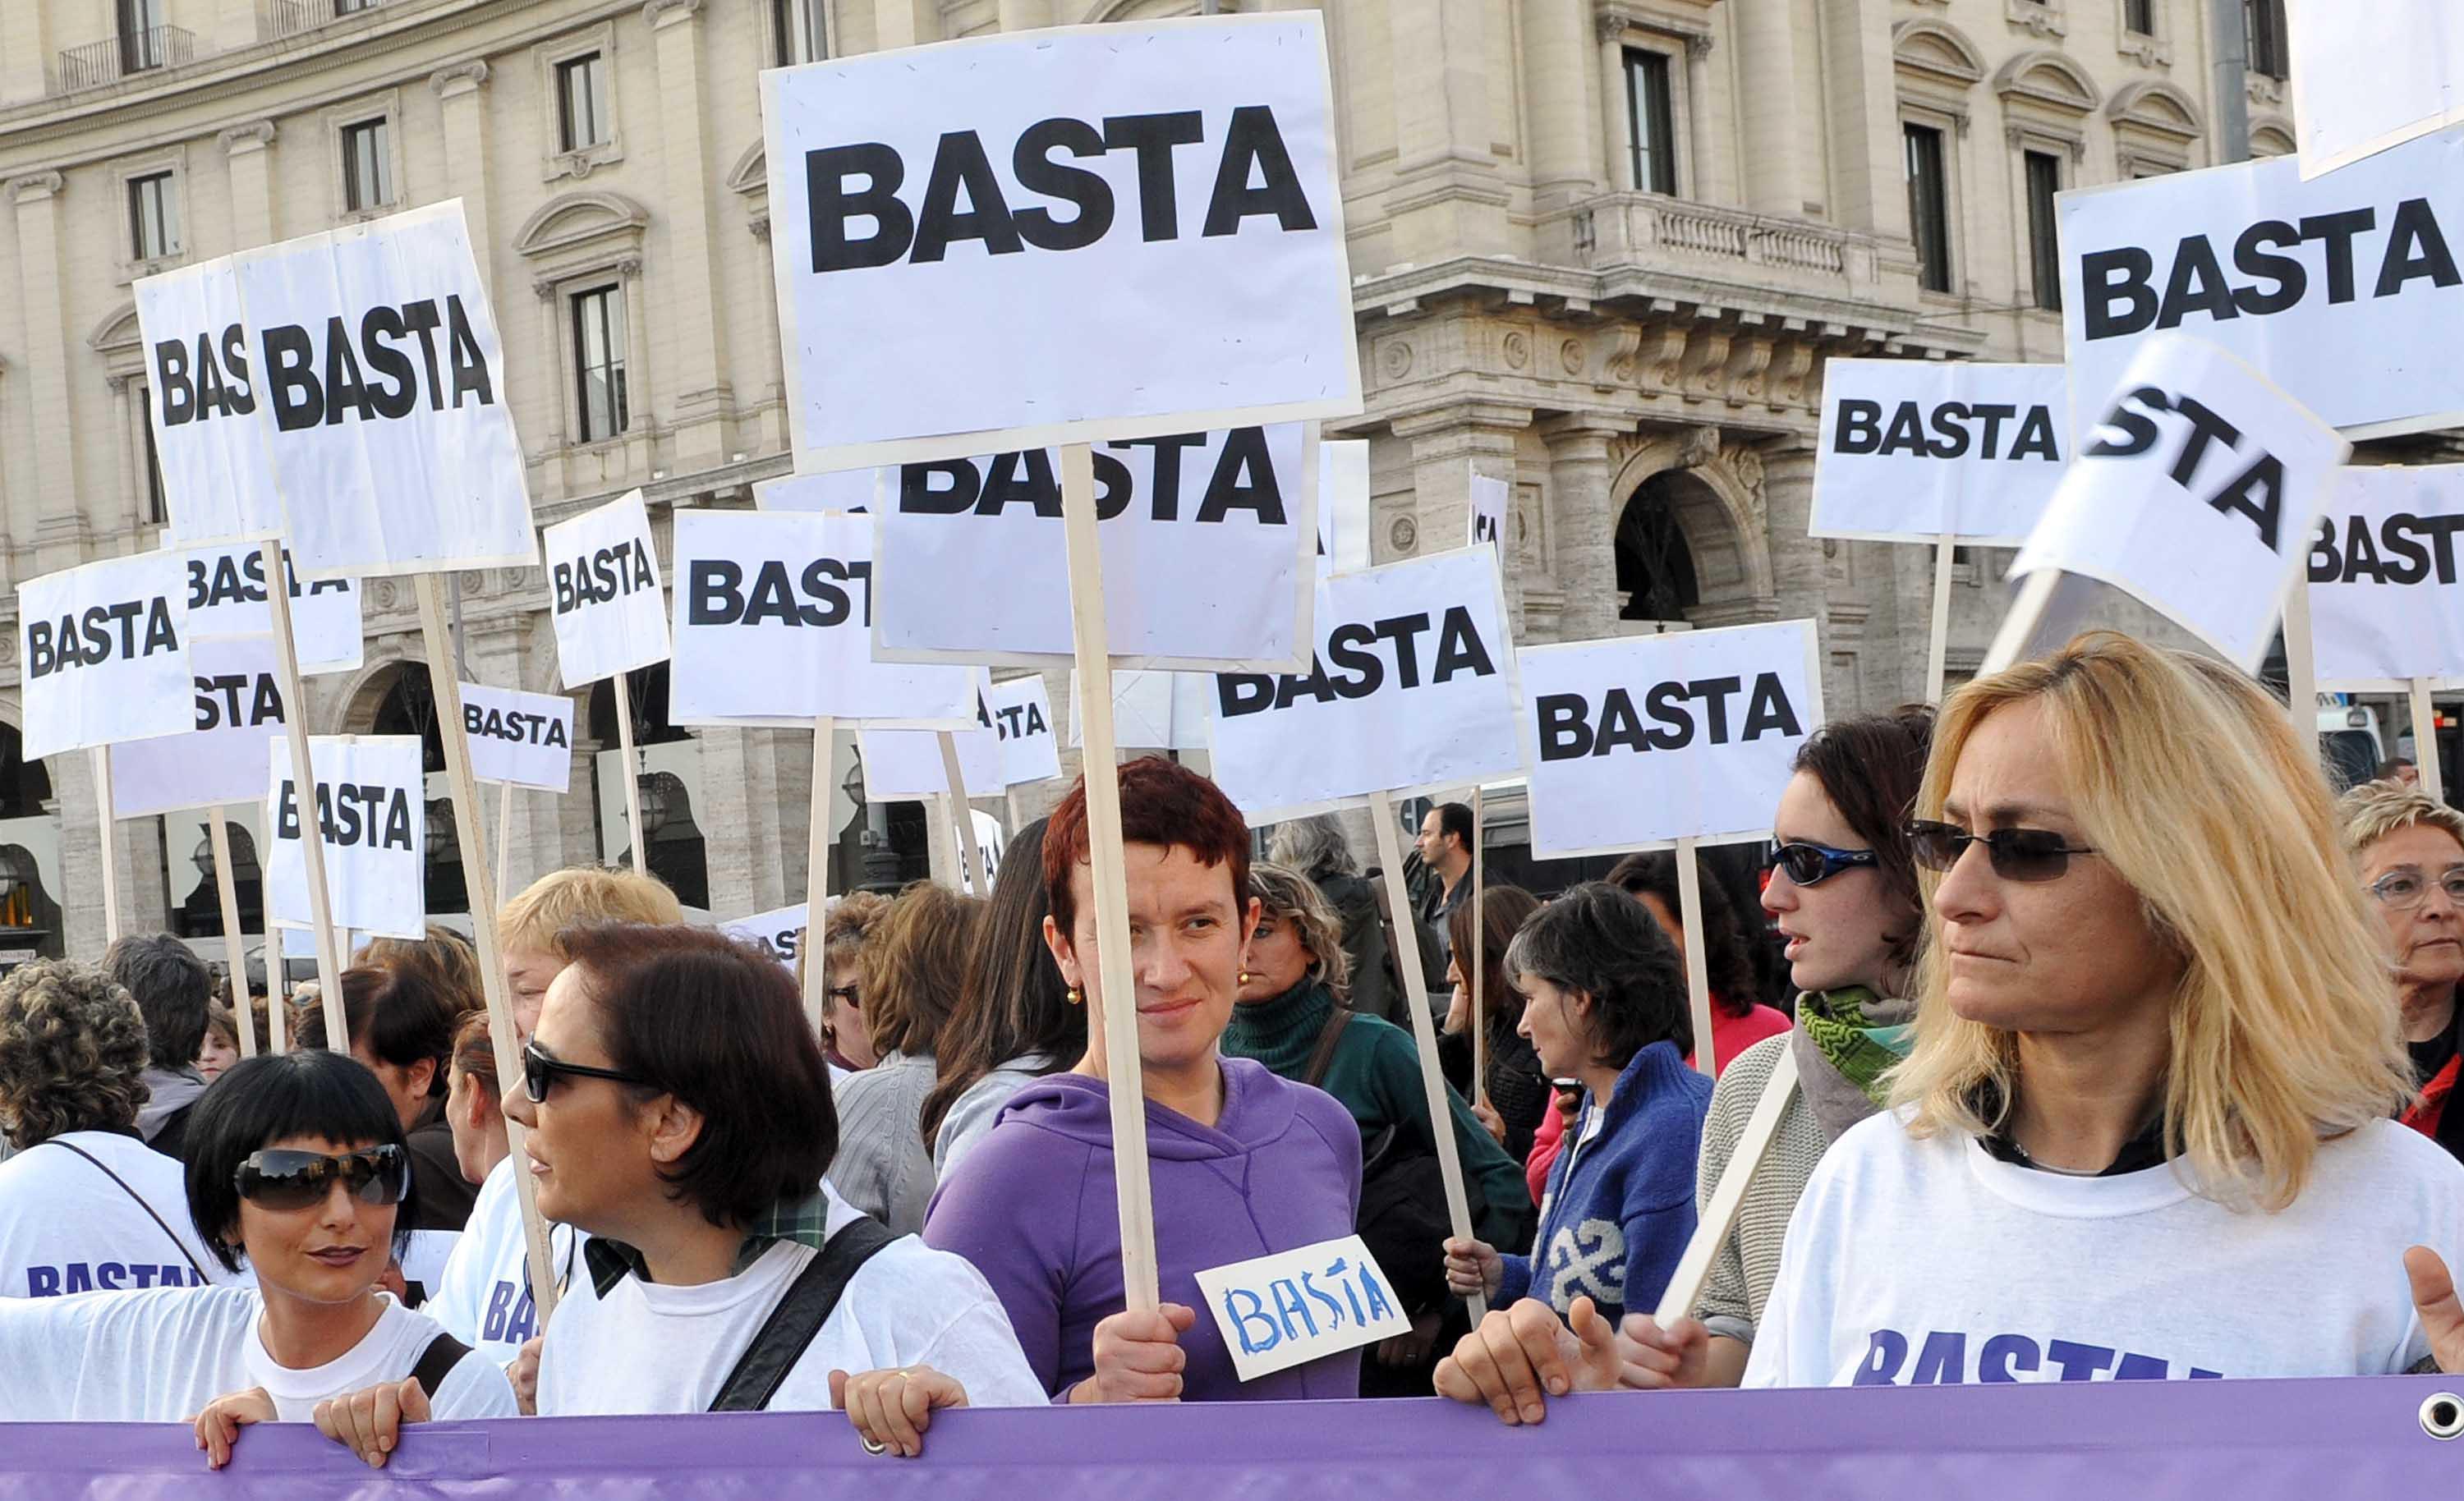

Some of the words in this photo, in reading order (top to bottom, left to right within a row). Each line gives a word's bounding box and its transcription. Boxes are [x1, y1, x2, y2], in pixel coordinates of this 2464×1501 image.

[806, 105, 1317, 273] BASTA
[2081, 197, 2463, 341] BASTA
[261, 295, 494, 432] BASTA
[1833, 398, 2060, 461] BASTA
[553, 537, 655, 615] BASTA
[2307, 512, 2464, 585] BAST
[28, 596, 179, 680] BASTA
[463, 703, 568, 749] BASTA
[1536, 672, 1804, 761] BASTA
[1223, 1257, 1395, 1356] BASTA
